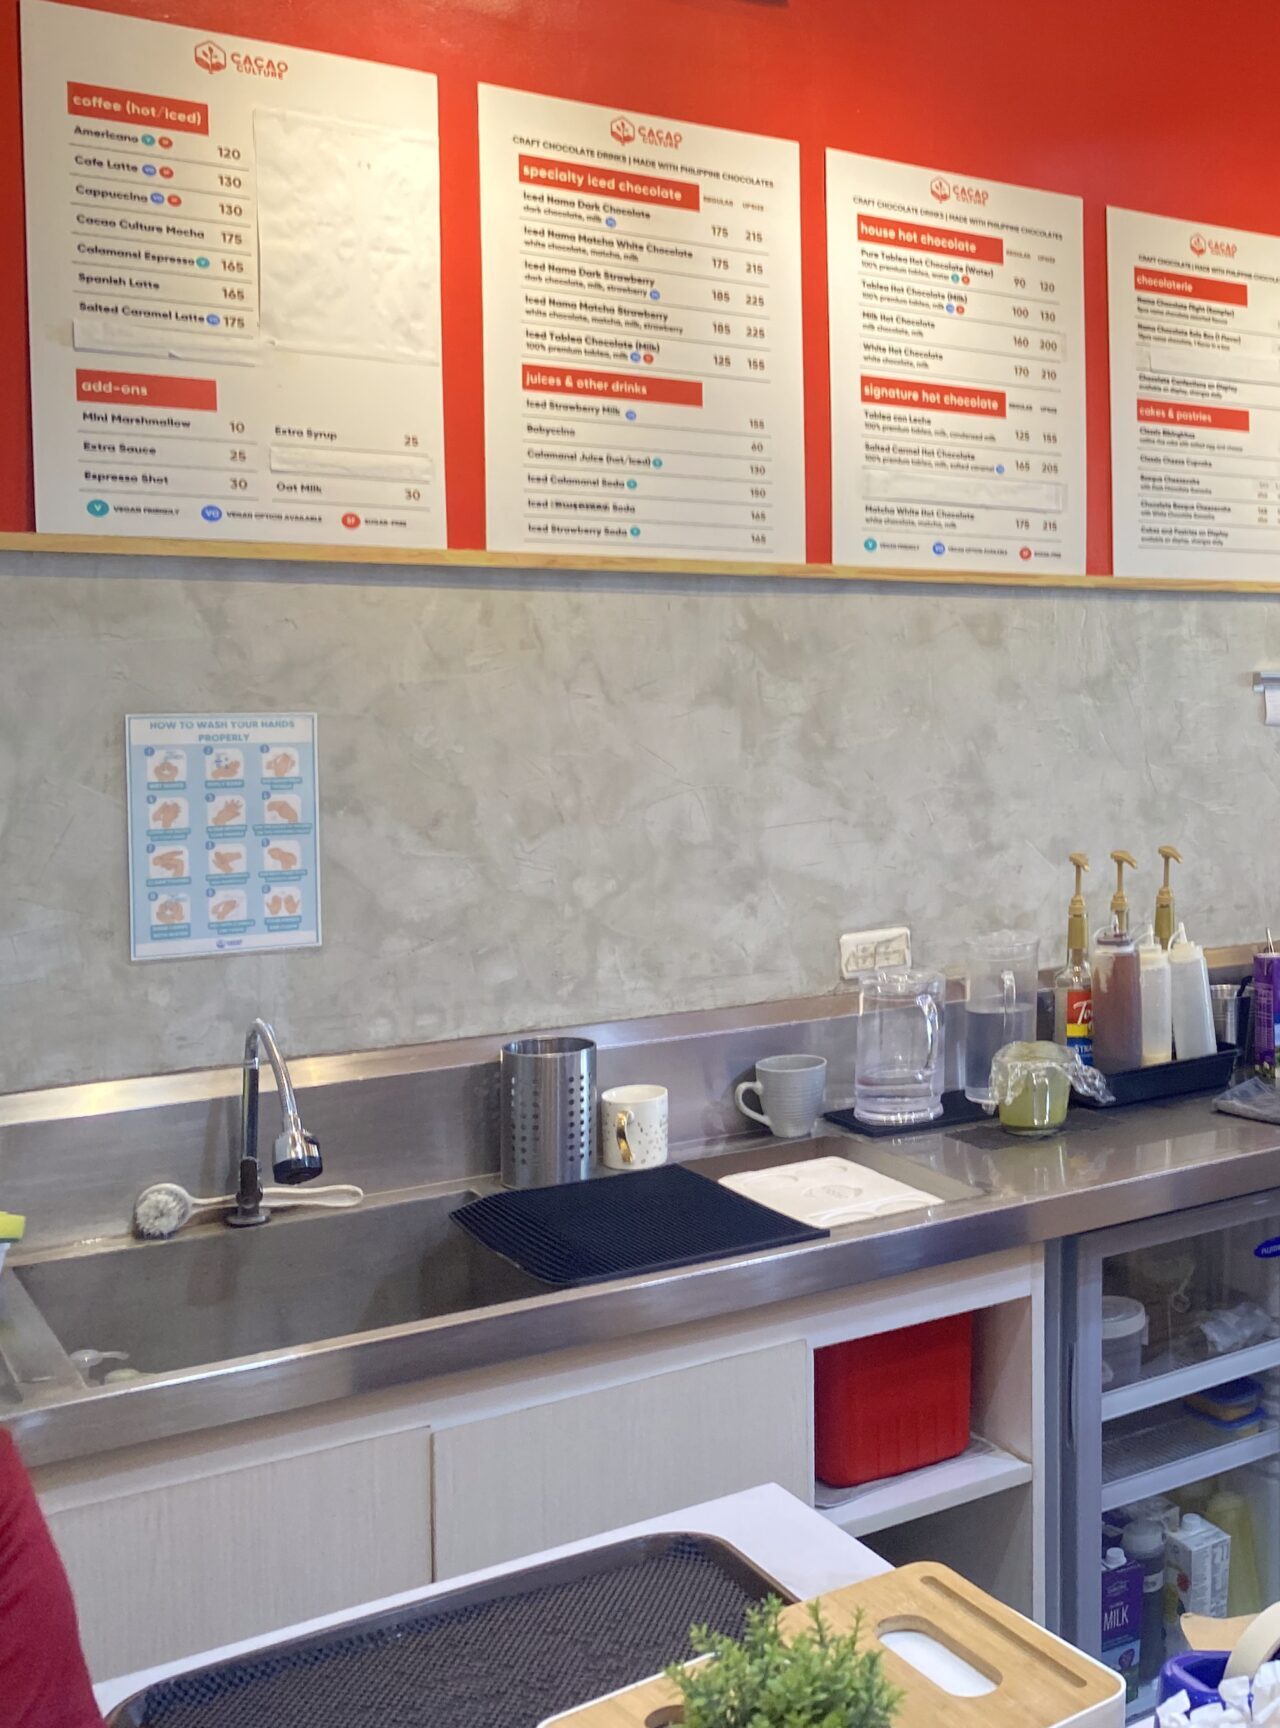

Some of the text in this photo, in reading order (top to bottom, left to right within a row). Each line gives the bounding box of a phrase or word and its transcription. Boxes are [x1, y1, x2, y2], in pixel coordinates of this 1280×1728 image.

[231, 53, 288, 73] CACAO
[237, 64, 283, 80] CULTURE
[73, 95, 201, 125] coffee (hot/iced)
[74, 125, 240, 160] Americano 120
[639, 127, 682, 144] CACAO
[643, 137, 679, 149] CULTURE
[75, 155, 242, 188] Cafe Latte 130
[513, 136, 541, 148] CRAFT
[543, 140, 595, 159] CHOCOLATE
[633, 157, 656, 169] MADE
[658, 161, 679, 173] WITH
[722, 171, 773, 188] CHOCOLATES
[523, 165, 682, 201] specialty iced chocolate
[953, 185, 989, 201] CACAO
[75, 185, 242, 216] Cappuccino 130
[77, 214, 242, 244] Cacao Culture Mocha 175
[523, 191, 762, 242] Iced Nama Dark Chocolate 175 215
[524, 226, 763, 274] Iced Nama Matcha White Chocolate 175 215
[860, 221, 976, 254] house hot chocolate
[77, 244, 243, 273] Calamansi Espresso 165
[861, 249, 879, 260] Pure
[881, 252, 907, 264] Tablea
[910, 256, 922, 266] Hot
[925, 258, 963, 273] Chocolate
[1014, 278, 1025, 288] 90
[1040, 281, 1054, 292] 120
[78, 273, 245, 300] Spanish Latte 165
[525, 261, 545, 271] Iced
[548, 264, 576, 276] Nama
[578, 267, 602, 279] Dark
[604, 271, 655, 287] Strawberry
[746, 295, 764, 306] 225
[1136, 274, 1193, 293] chocolaterie
[80, 303, 245, 328] Salted Caramel Latte 175
[906, 286, 945, 301] Chocolate
[1013, 307, 1028, 318] 100
[1041, 311, 1055, 321] 130
[525, 295, 546, 306] Iced
[548, 298, 577, 309] Nama
[580, 301, 615, 314] Matcha
[618, 305, 668, 322] Strawberry
[746, 327, 764, 339] 225
[526, 330, 764, 370] Iced Tablea Chocolate (Milk) 125 155
[904, 347, 943, 360] Chocolate
[1014, 366, 1029, 377] 170
[81, 380, 147, 397] add-ons
[526, 372, 647, 394] juices & other drinks
[527, 400, 546, 409] Iced
[549, 402, 600, 416] Strawberry
[602, 406, 620, 415] Milk
[864, 384, 998, 410] signature hot chocolate
[83, 412, 245, 433] Mini Marshmallow 10
[1139, 405, 1166, 419] cakes
[1177, 409, 1212, 425] pastries
[275, 427, 419, 447] Extra Syrup 25
[83, 442, 246, 462] Extra Sauce 25
[84, 471, 247, 489] Espresso Shot 30
[277, 484, 420, 500] Oat Milk 30
[150, 720, 295, 730] HOW TO WASH YOUR HANDS
[198, 733, 249, 742] PROPERLY
[1103, 1605, 1128, 1632] MILK
